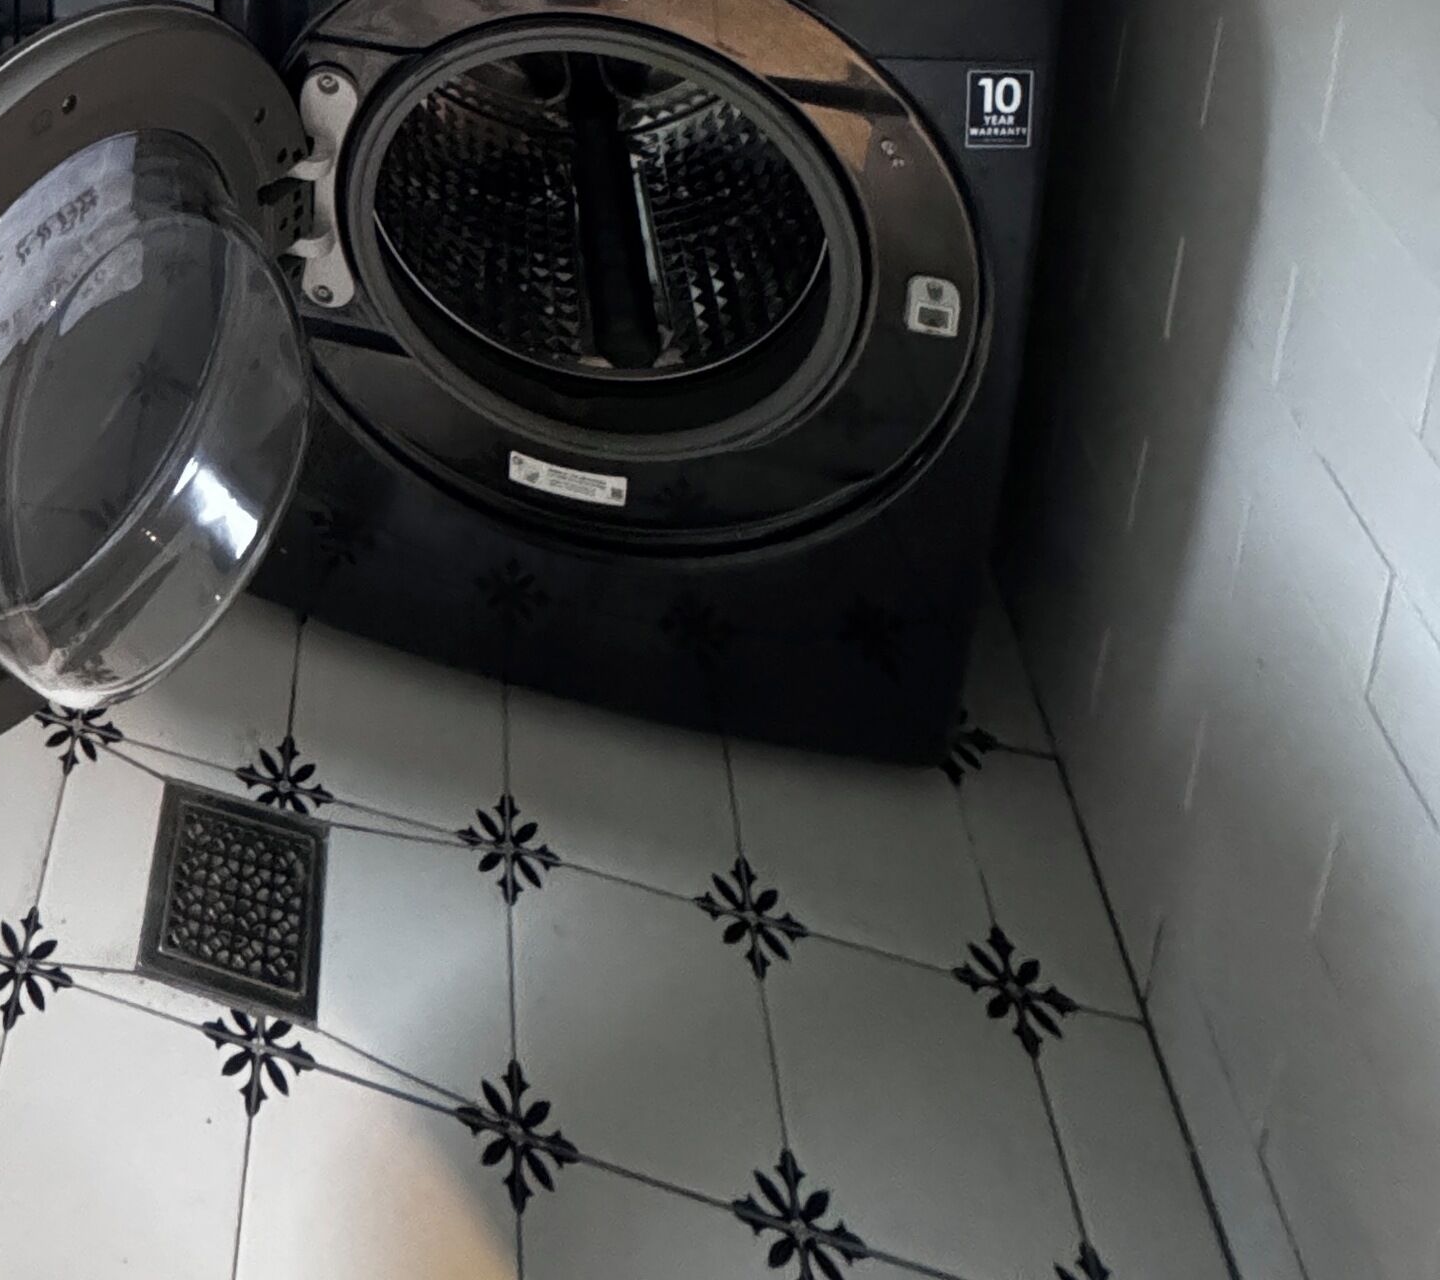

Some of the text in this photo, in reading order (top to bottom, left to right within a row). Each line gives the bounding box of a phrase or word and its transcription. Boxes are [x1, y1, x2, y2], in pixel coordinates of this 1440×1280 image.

[977, 76, 1022, 114] 10
[983, 115, 1014, 126] YEAR
[969, 127, 1027, 136] WARRANTY
